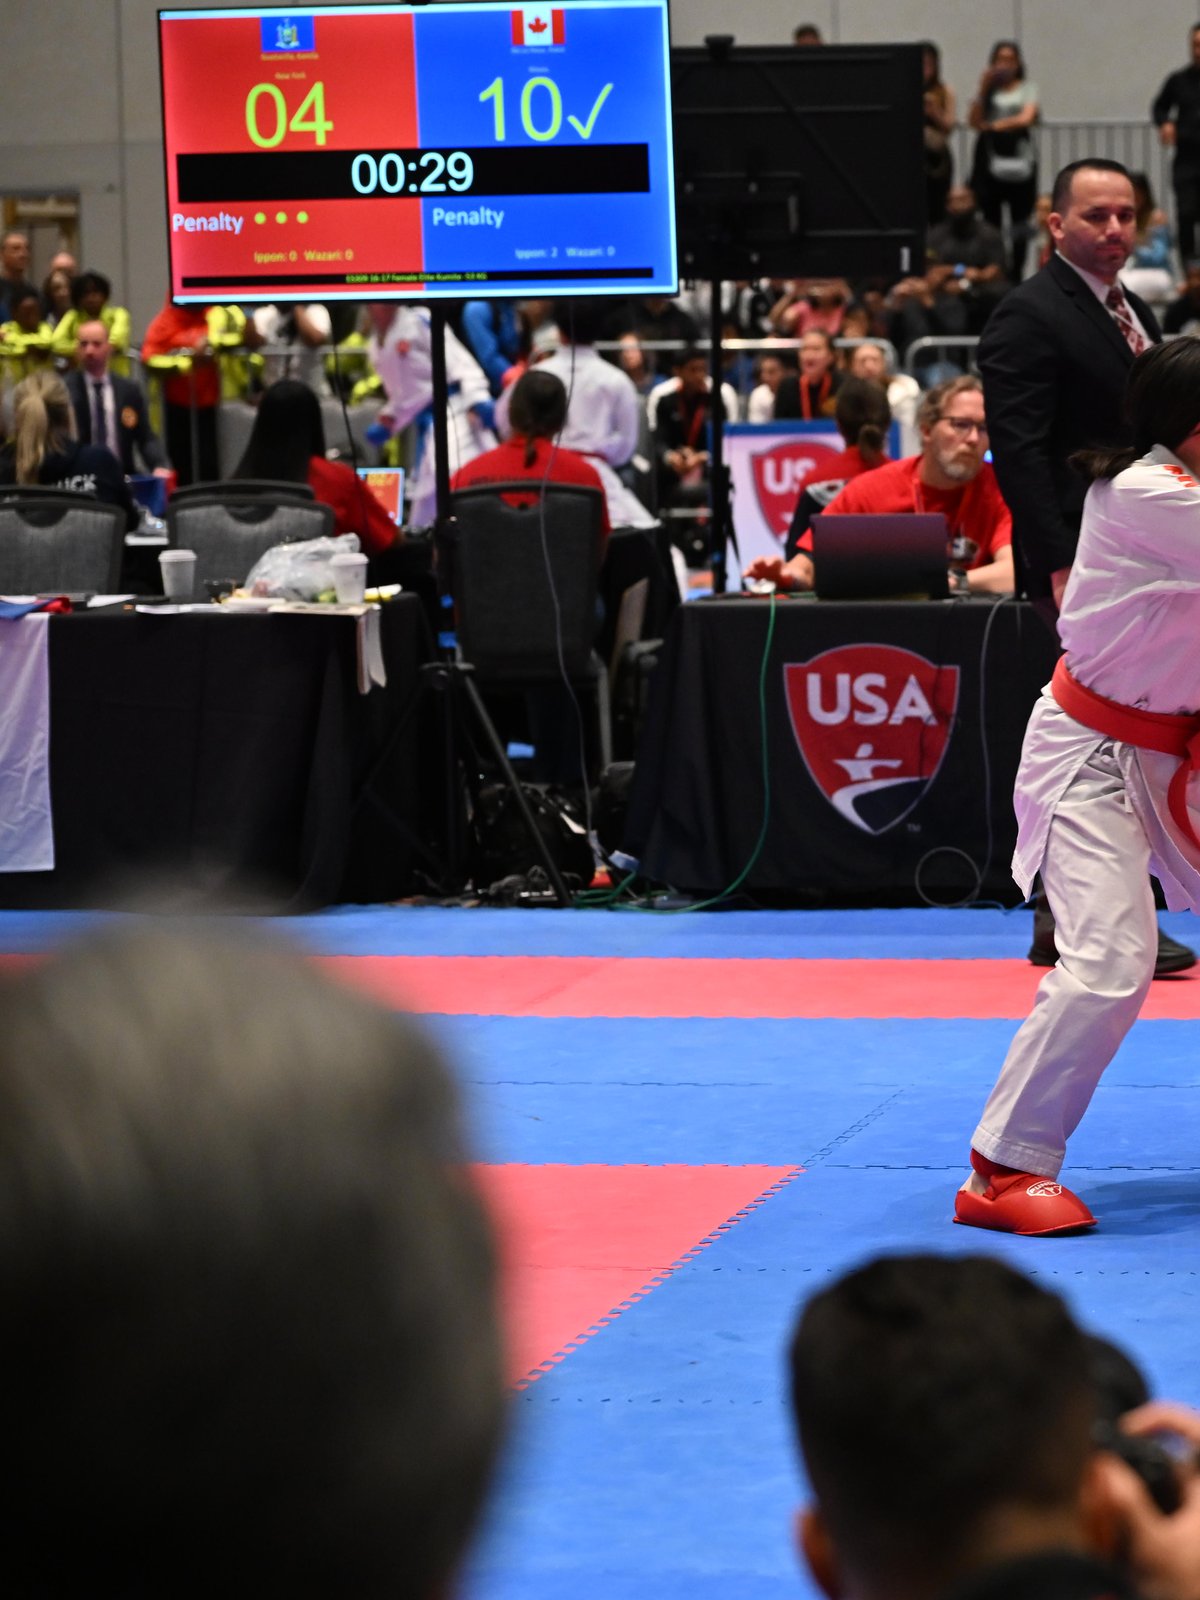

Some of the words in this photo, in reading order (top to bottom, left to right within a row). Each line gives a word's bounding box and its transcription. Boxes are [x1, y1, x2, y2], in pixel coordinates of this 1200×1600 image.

[245, 82, 334, 148] 04
[478, 76, 562, 142] 10
[351, 151, 474, 194] 00:29
[172, 212, 244, 235] Penalty
[432, 206, 504, 229] Penalty
[254, 251, 287, 264] Ippon:
[304, 250, 342, 262] Wazari:
[763, 458, 817, 495] US
[807, 673, 938, 726] USA
